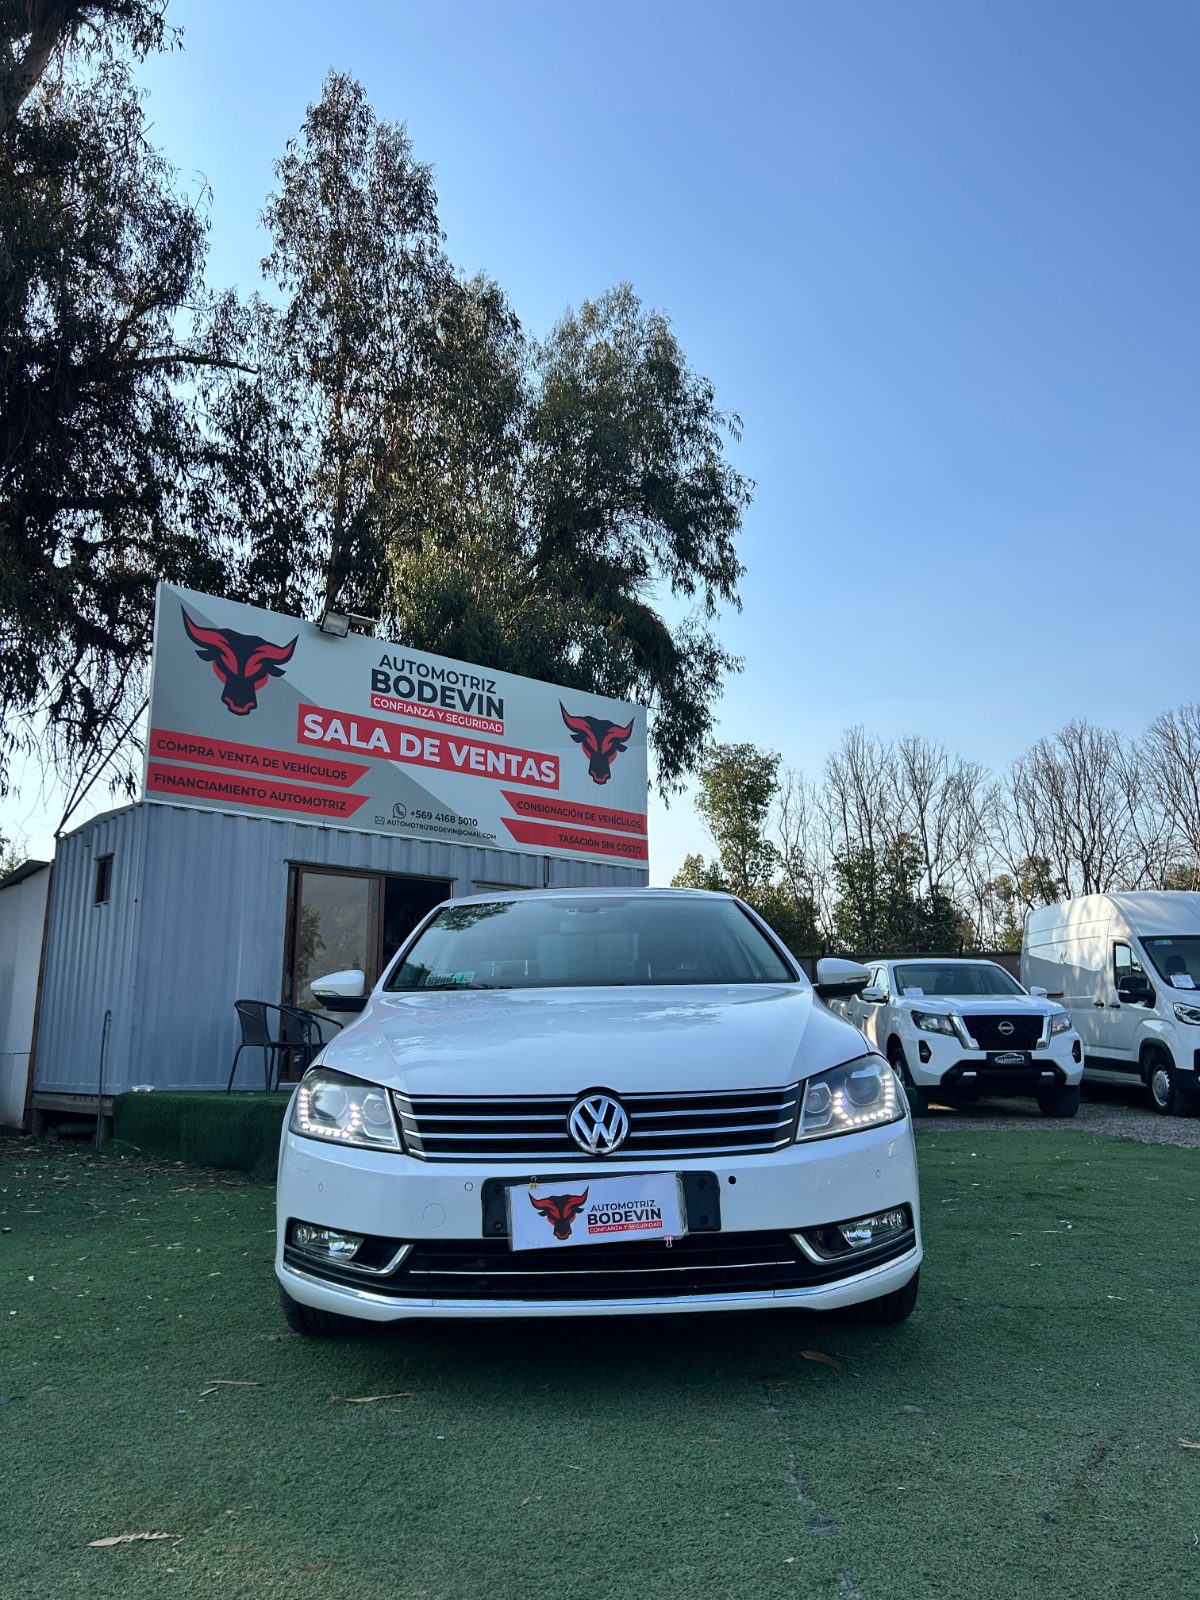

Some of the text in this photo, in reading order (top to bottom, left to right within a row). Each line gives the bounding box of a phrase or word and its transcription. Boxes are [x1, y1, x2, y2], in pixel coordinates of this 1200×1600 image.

[379, 654, 497, 694] AUTOMOTRIZ
[371, 668, 504, 720] BODEVIN
[373, 697, 503, 733] CONFIANZA Y SEGURIDAD
[156, 739, 348, 780] COMPRA VENTA DE VEHÍCULOS
[303, 713, 556, 783] SALA DE VENTAS
[154, 773, 347, 811] FINANCIAMIENTO AUTOMOTRIZ
[410, 810, 478, 827] +569 4168 5010
[517, 801, 642, 829] CONSIGNACIÓN DE VEHÍCULOS
[558, 834, 642, 854] TASACIÓN SIN COSTO
[587, 1207, 662, 1226] BODEVIN
[590, 1199, 656, 1212] AUTOMOTRIZ
[628, 1221, 662, 1230] SEGURIDAD
